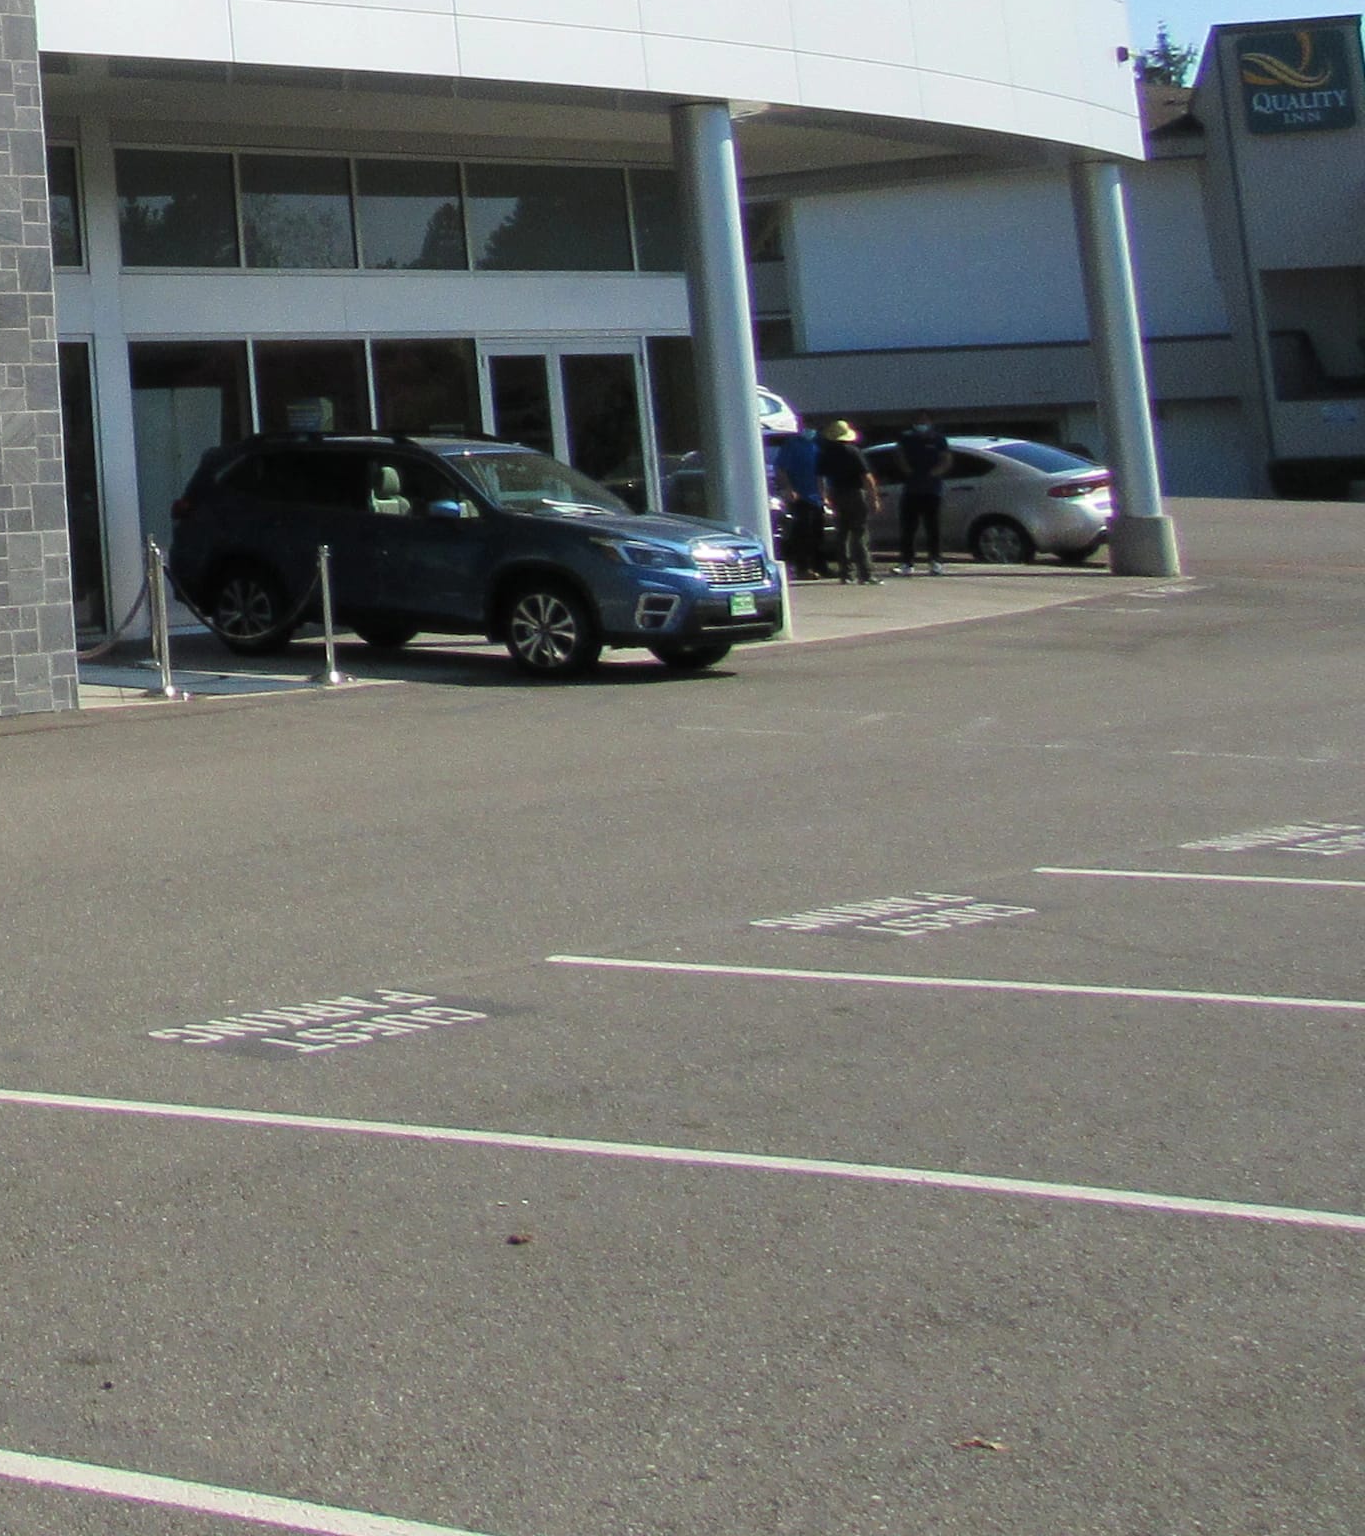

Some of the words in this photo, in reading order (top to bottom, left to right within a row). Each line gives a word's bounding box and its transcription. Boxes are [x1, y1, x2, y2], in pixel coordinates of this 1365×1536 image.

[1252, 89, 1347, 114] QUALITY
[1284, 111, 1321, 124] INN
[148, 989, 437, 1043] PARKING
[261, 1006, 487, 1052] GUEST
